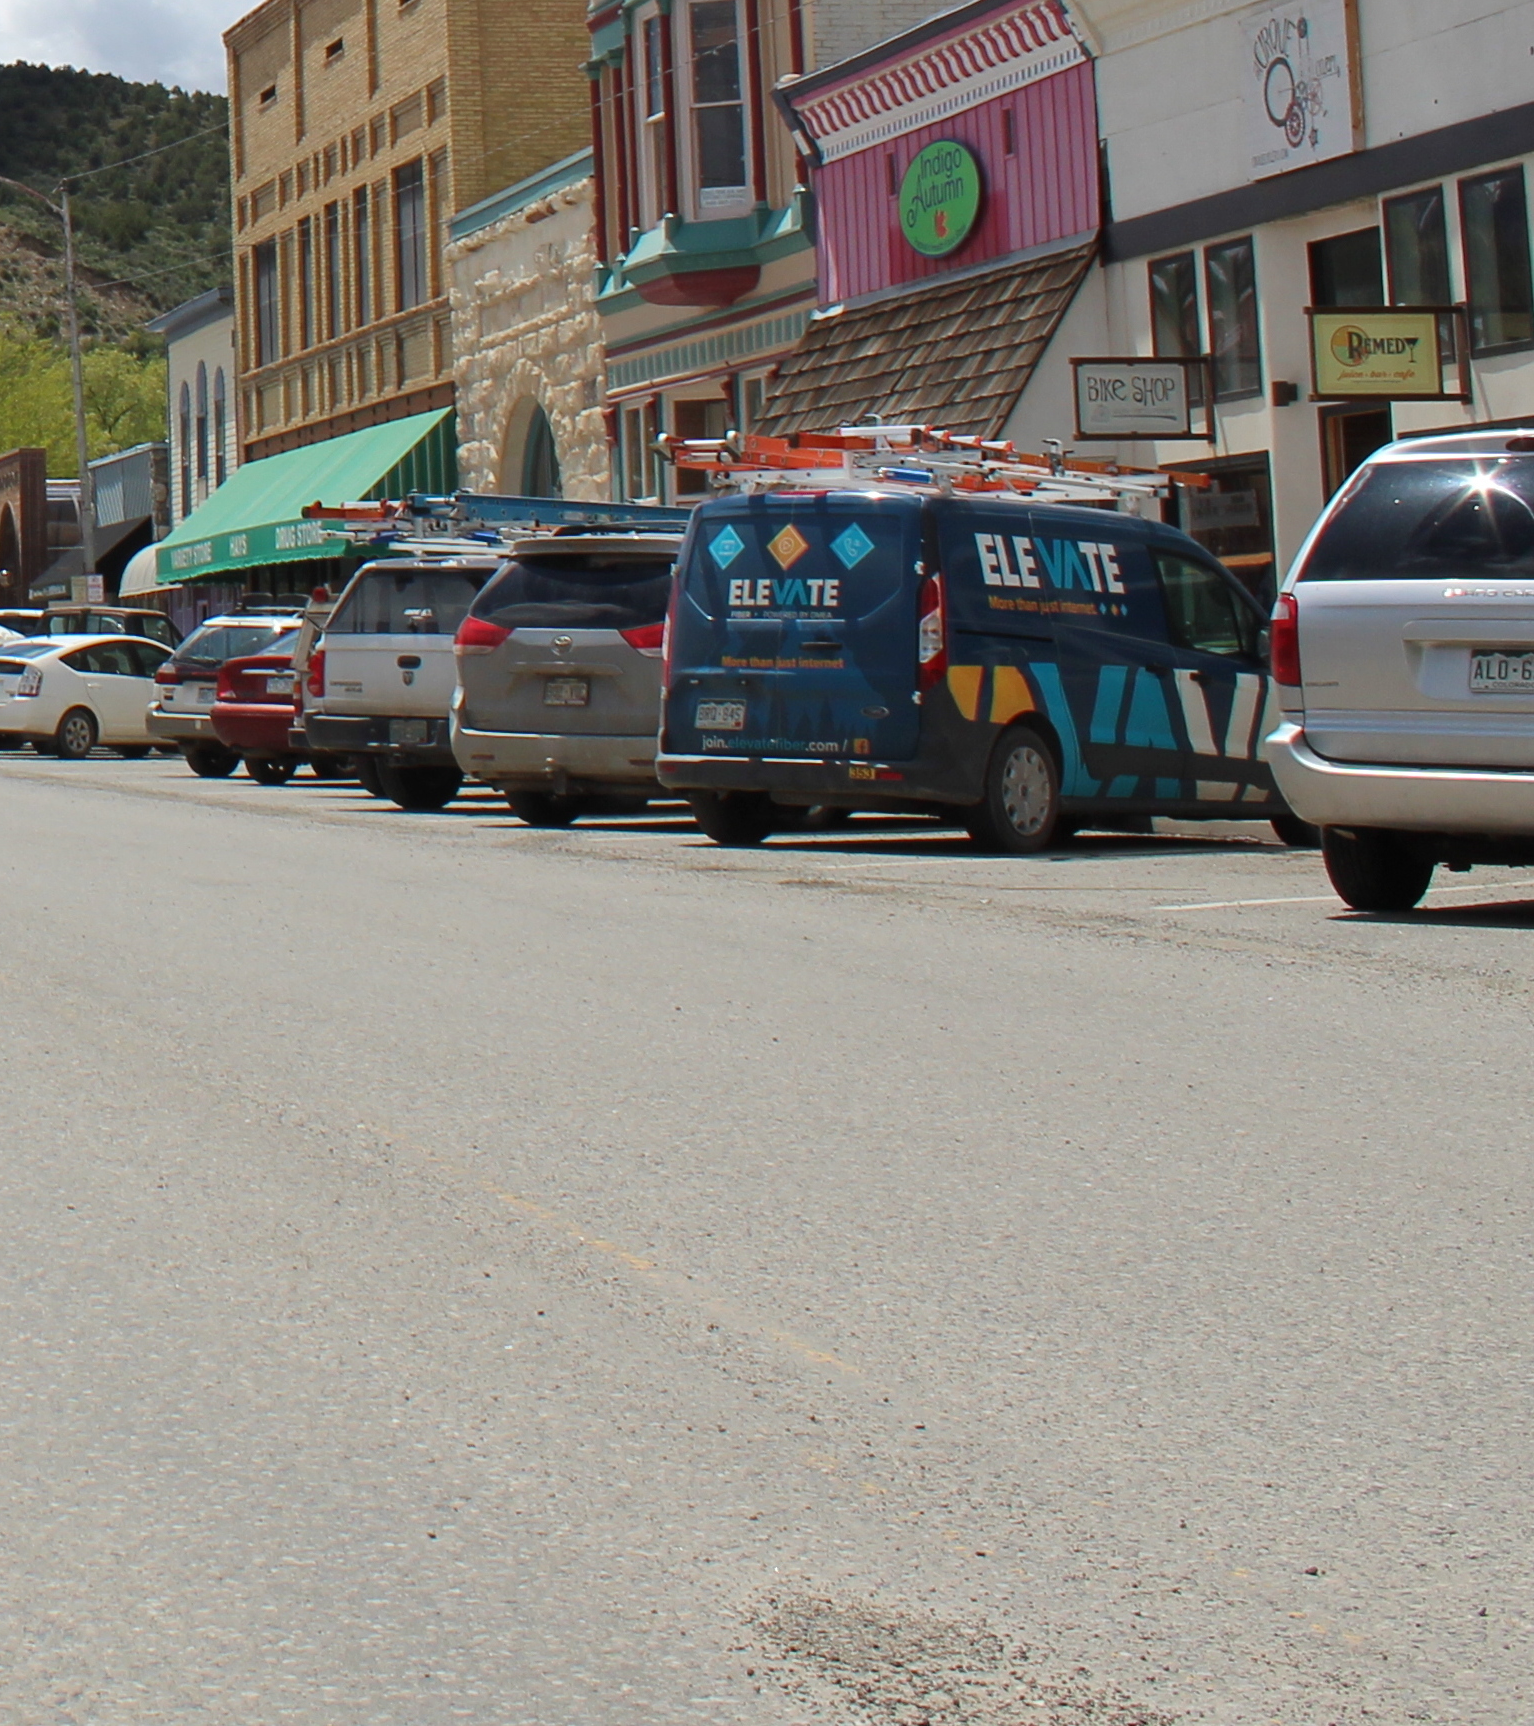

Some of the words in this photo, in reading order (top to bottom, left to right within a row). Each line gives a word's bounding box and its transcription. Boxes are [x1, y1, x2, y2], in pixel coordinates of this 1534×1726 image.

[920, 148, 962, 179] Indigo
[906, 174, 964, 228] Autumn
[1131, 375, 1176, 407] SHOP
[974, 532, 1127, 595] ELEVATE
[728, 578, 840, 607] ELEVATE
[988, 595, 1016, 611] More
[721, 655, 748, 667] More
[749, 656, 774, 667] than
[775, 656, 797, 669] just
[798, 657, 845, 669] internet
